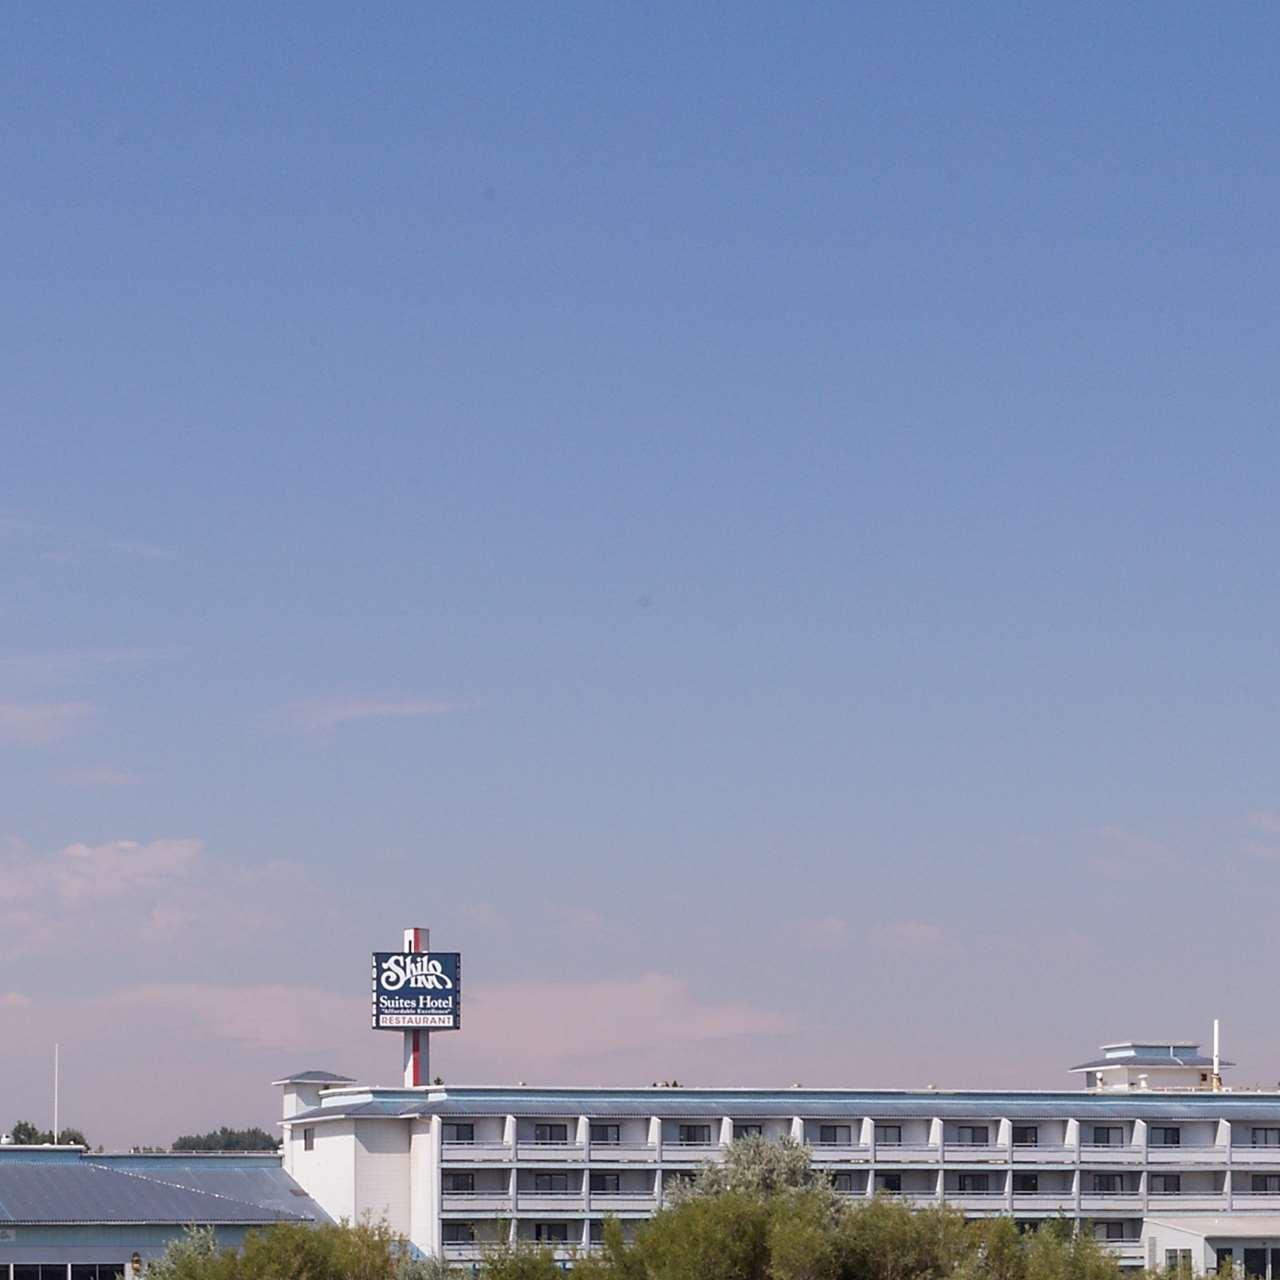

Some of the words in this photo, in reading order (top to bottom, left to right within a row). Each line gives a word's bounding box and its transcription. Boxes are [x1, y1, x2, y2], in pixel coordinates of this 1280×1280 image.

[380, 955, 453, 990] Shilo
[379, 995, 416, 1008] Suites
[419, 995, 453, 1008] Hotel
[381, 1017, 451, 1025] RESTAURANT
